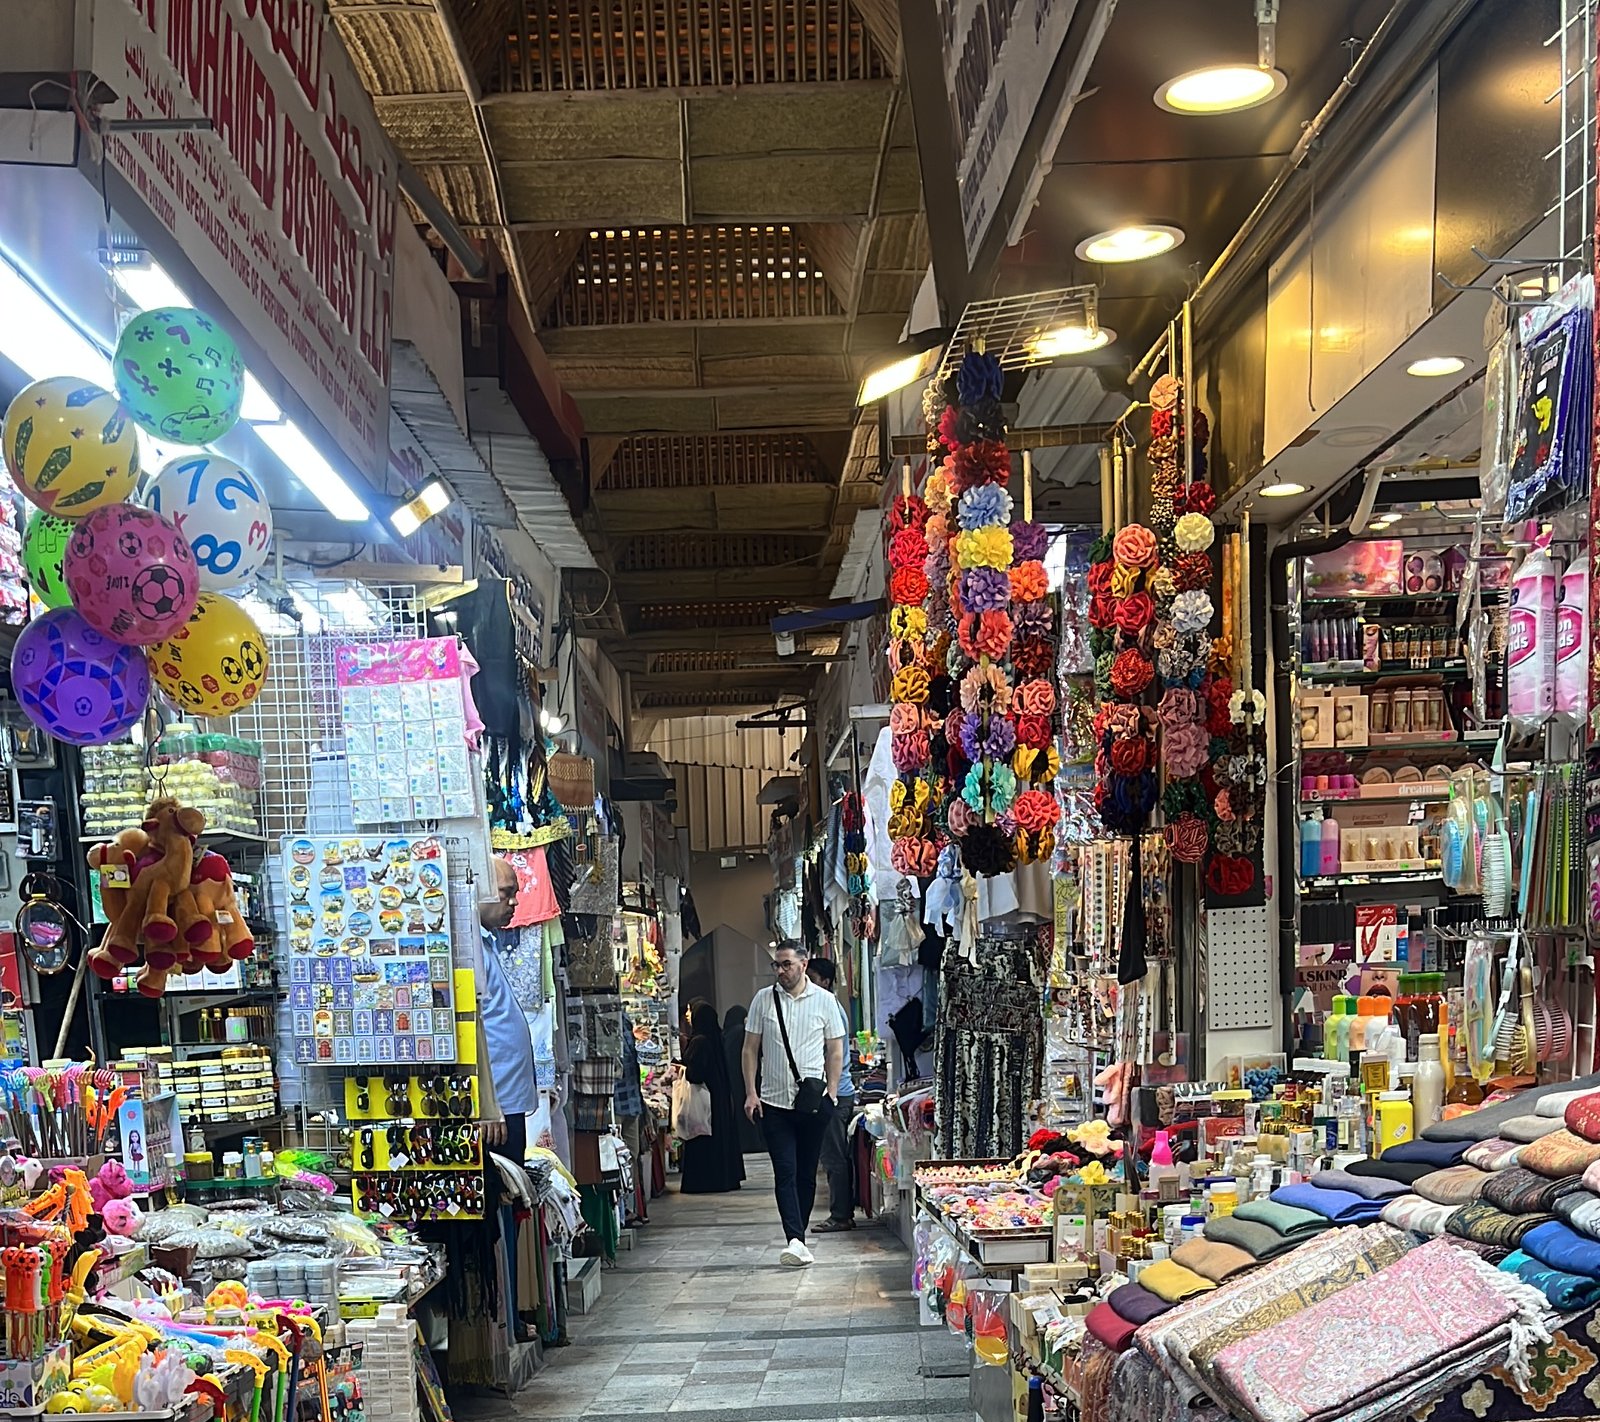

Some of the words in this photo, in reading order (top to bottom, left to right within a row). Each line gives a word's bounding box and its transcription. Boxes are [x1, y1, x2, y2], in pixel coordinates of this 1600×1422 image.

[325, 73, 374, 225] محمد
[155, 135, 175, 192] SALE
[175, 164, 184, 205] IN
[184, 178, 230, 262] SPECIALIZED
[282, 111, 356, 335] BUSINESS
[177, 459, 210, 506] 7
[214, 469, 260, 511] 2
[191, 533, 242, 575] 8
[248, 520, 267, 551] 3
[1399, 783, 1434, 795] dream
